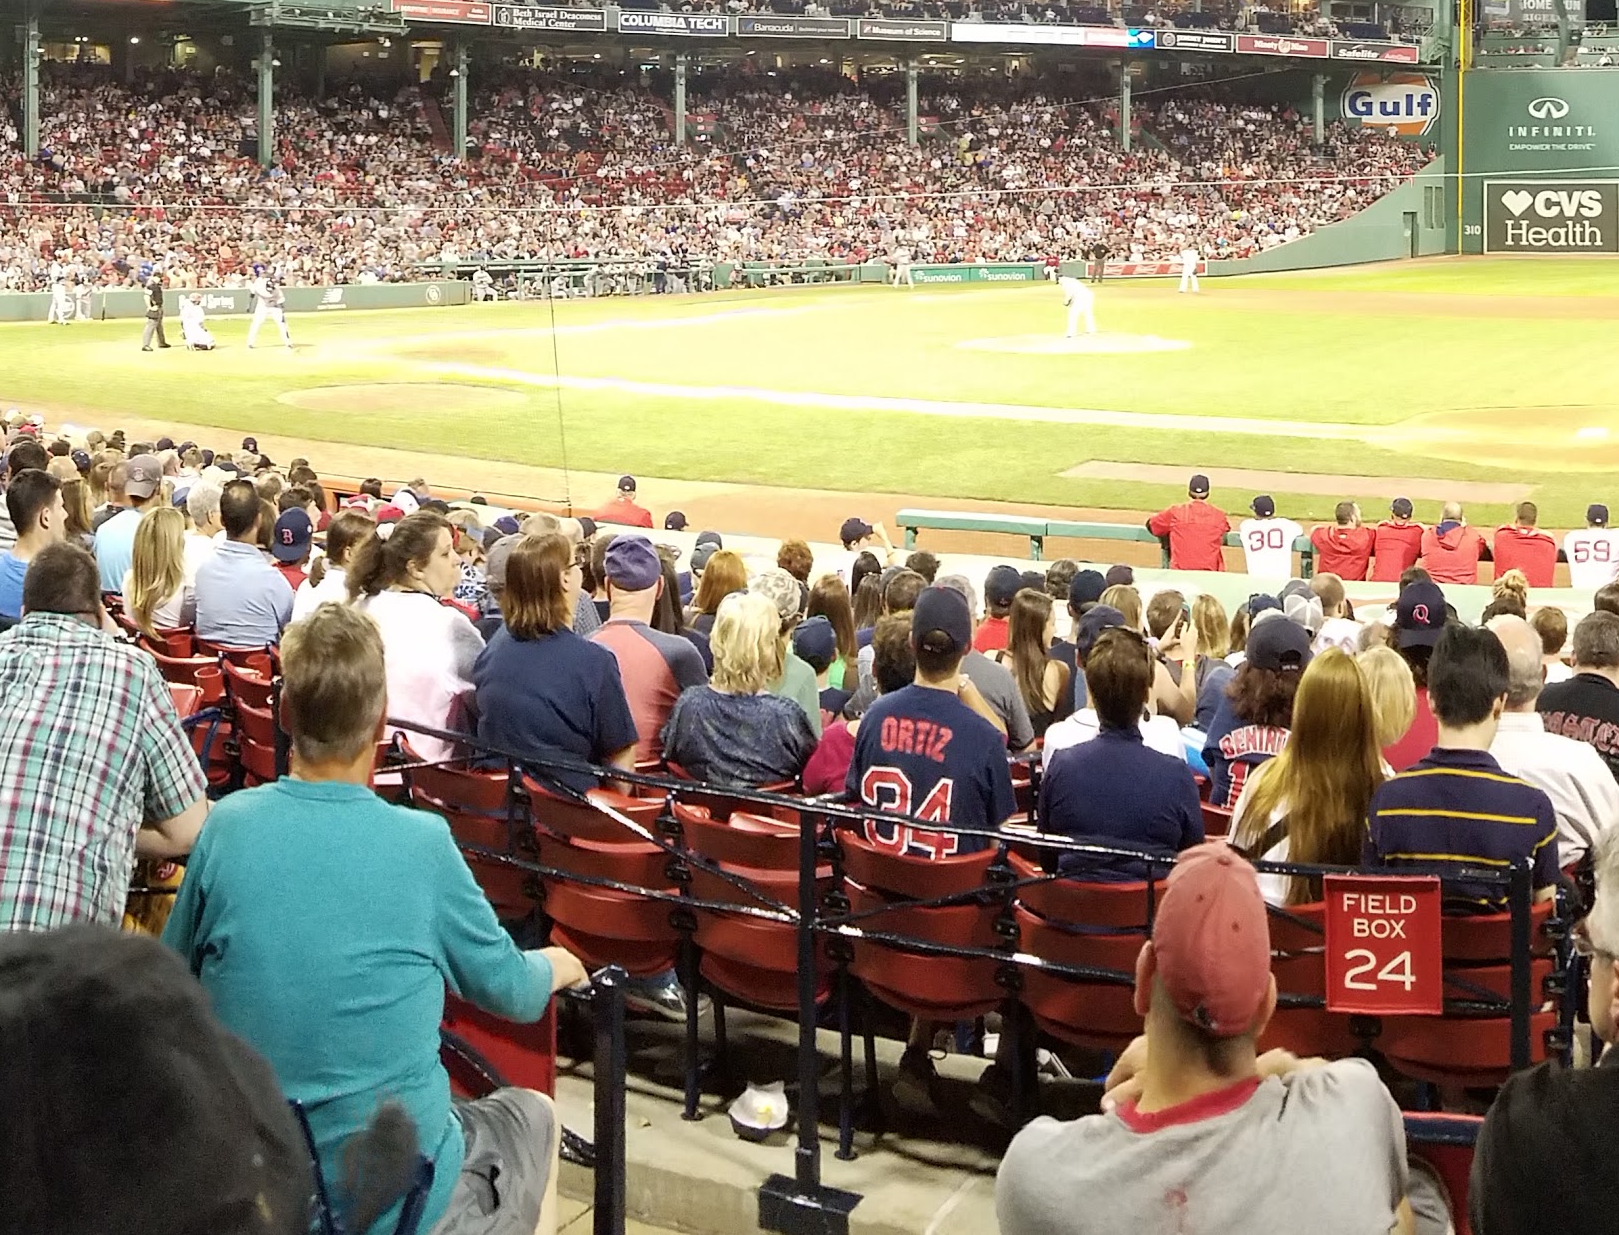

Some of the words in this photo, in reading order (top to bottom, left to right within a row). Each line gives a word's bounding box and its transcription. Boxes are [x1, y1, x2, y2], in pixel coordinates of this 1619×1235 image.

[513, 8, 531, 18] Beth
[533, 10, 557, 20] Israel
[560, 12, 602, 22] Deaconess
[513, 17, 546, 28] Medical
[548, 19, 576, 29] Center
[621, 15, 686, 29] COLUMBIA
[689, 16, 724, 30] TECH
[754, 23, 794, 33] Barracuda
[914, 28, 941, 37] Science
[1338, 47, 1380, 60] Safelite
[1348, 91, 1432, 117] Gulf
[1534, 190, 1603, 217] CVS
[1464, 224, 1482, 235] 310
[1505, 220, 1603, 247] Health
[922, 271, 962, 283] sunovion
[986, 270, 1026, 281] sunovion
[1248, 530, 1285, 552] 30
[1573, 540, 1612, 564] 59
[881, 715, 953, 762] ORTIZ
[861, 765, 959, 861] 34
[1344, 892, 1417, 916] FIELD
[1353, 917, 1407, 939] BOX
[1344, 950, 1417, 992] 24
